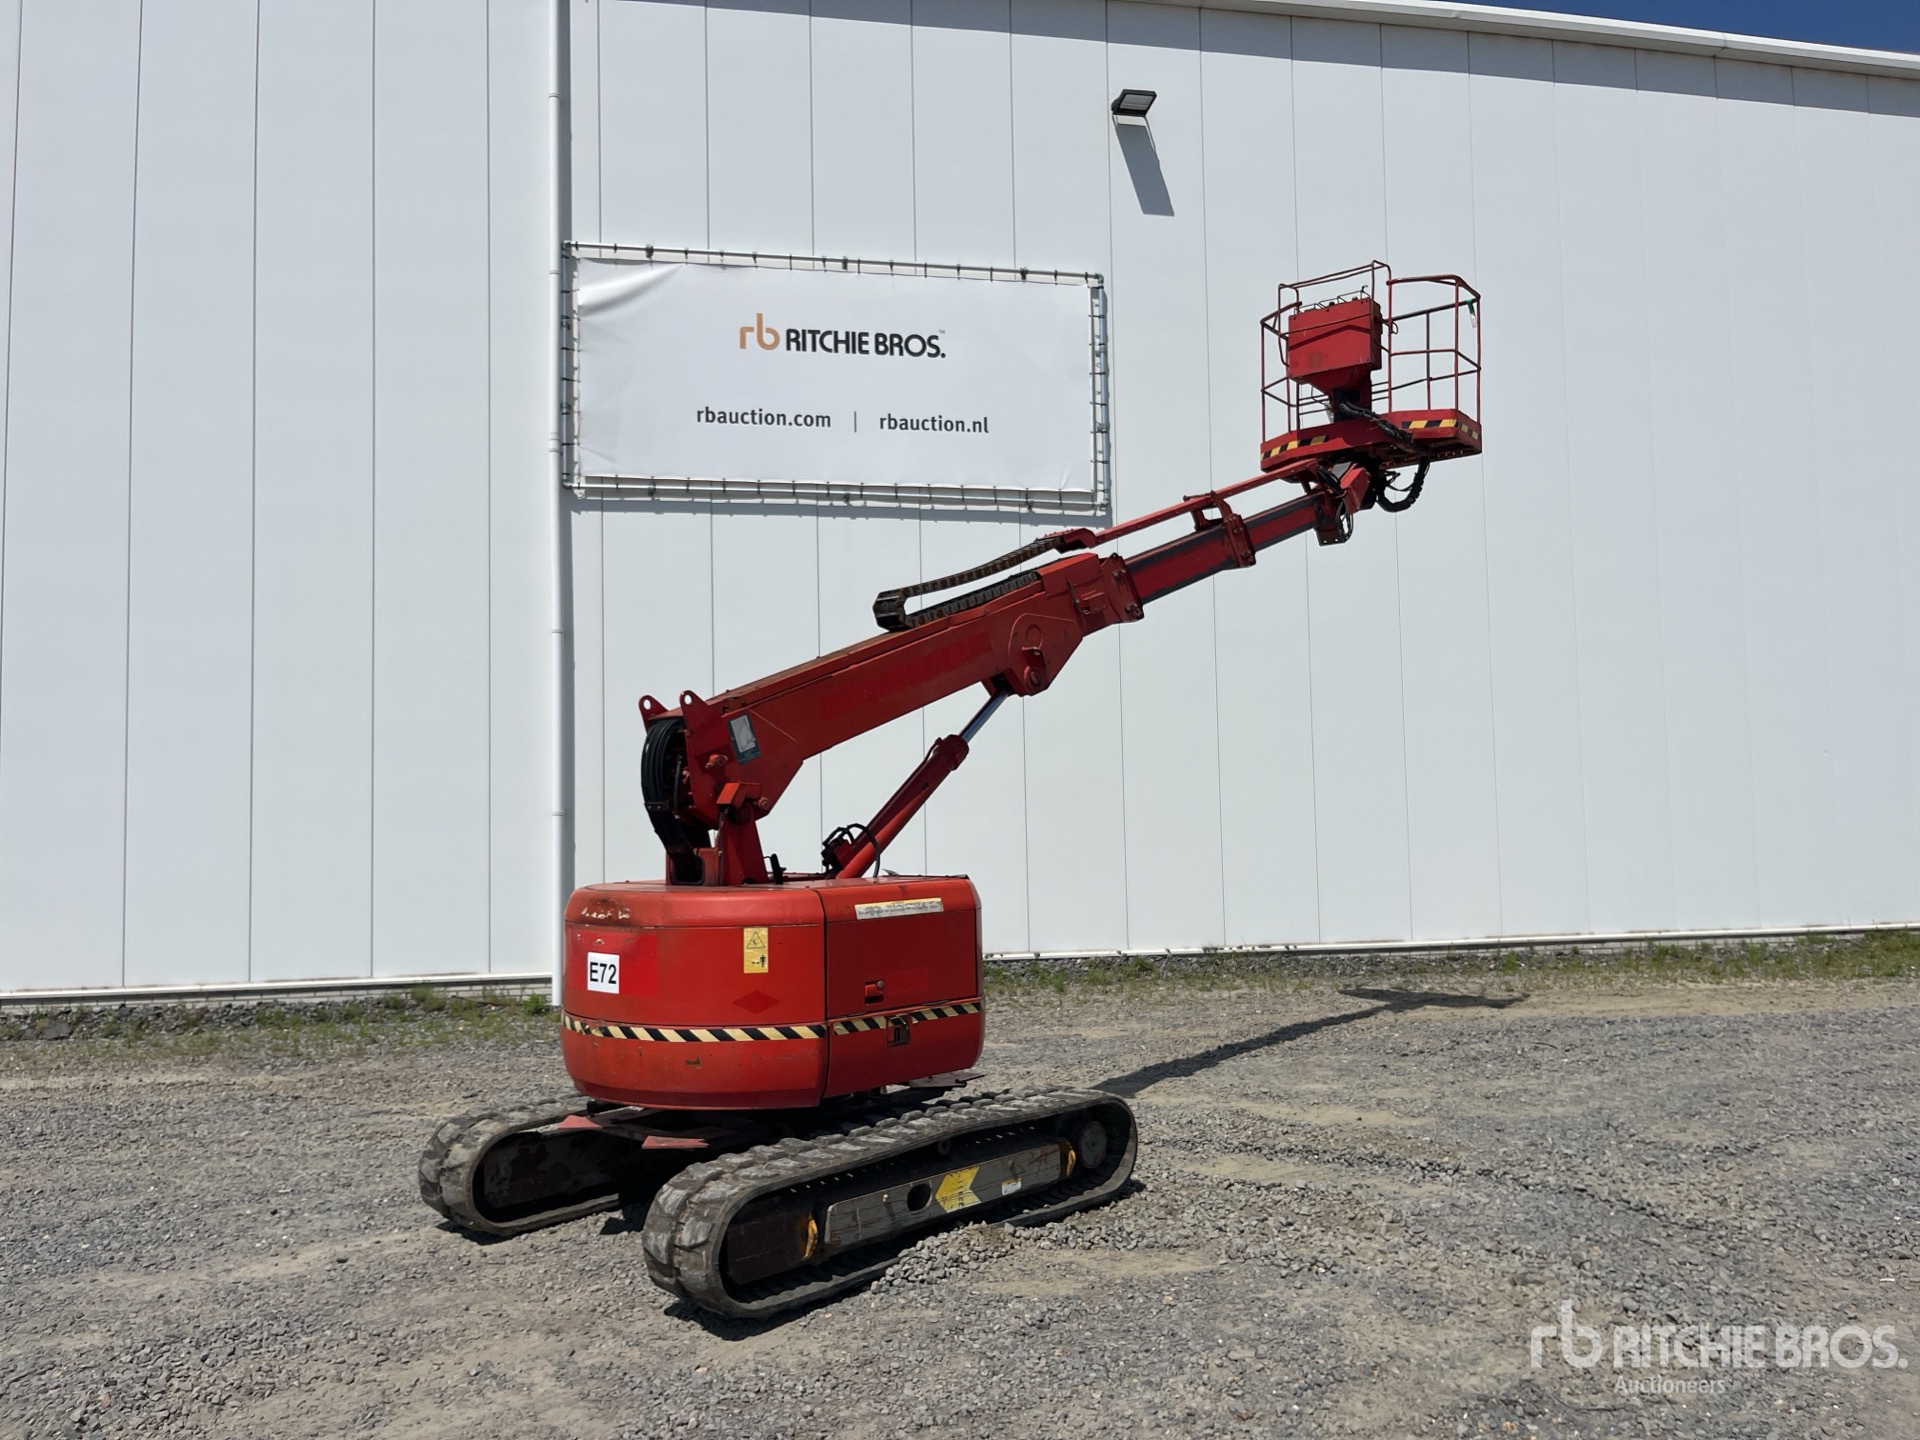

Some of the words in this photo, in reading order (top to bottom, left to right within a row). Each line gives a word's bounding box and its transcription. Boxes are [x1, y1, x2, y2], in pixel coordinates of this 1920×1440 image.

[739, 312, 780, 351] rb
[785, 328, 870, 355] RITCHIE
[696, 406, 832, 428] rbauction.com
[879, 413, 989, 433] rbauction.nl
[590, 962, 617, 984] E72
